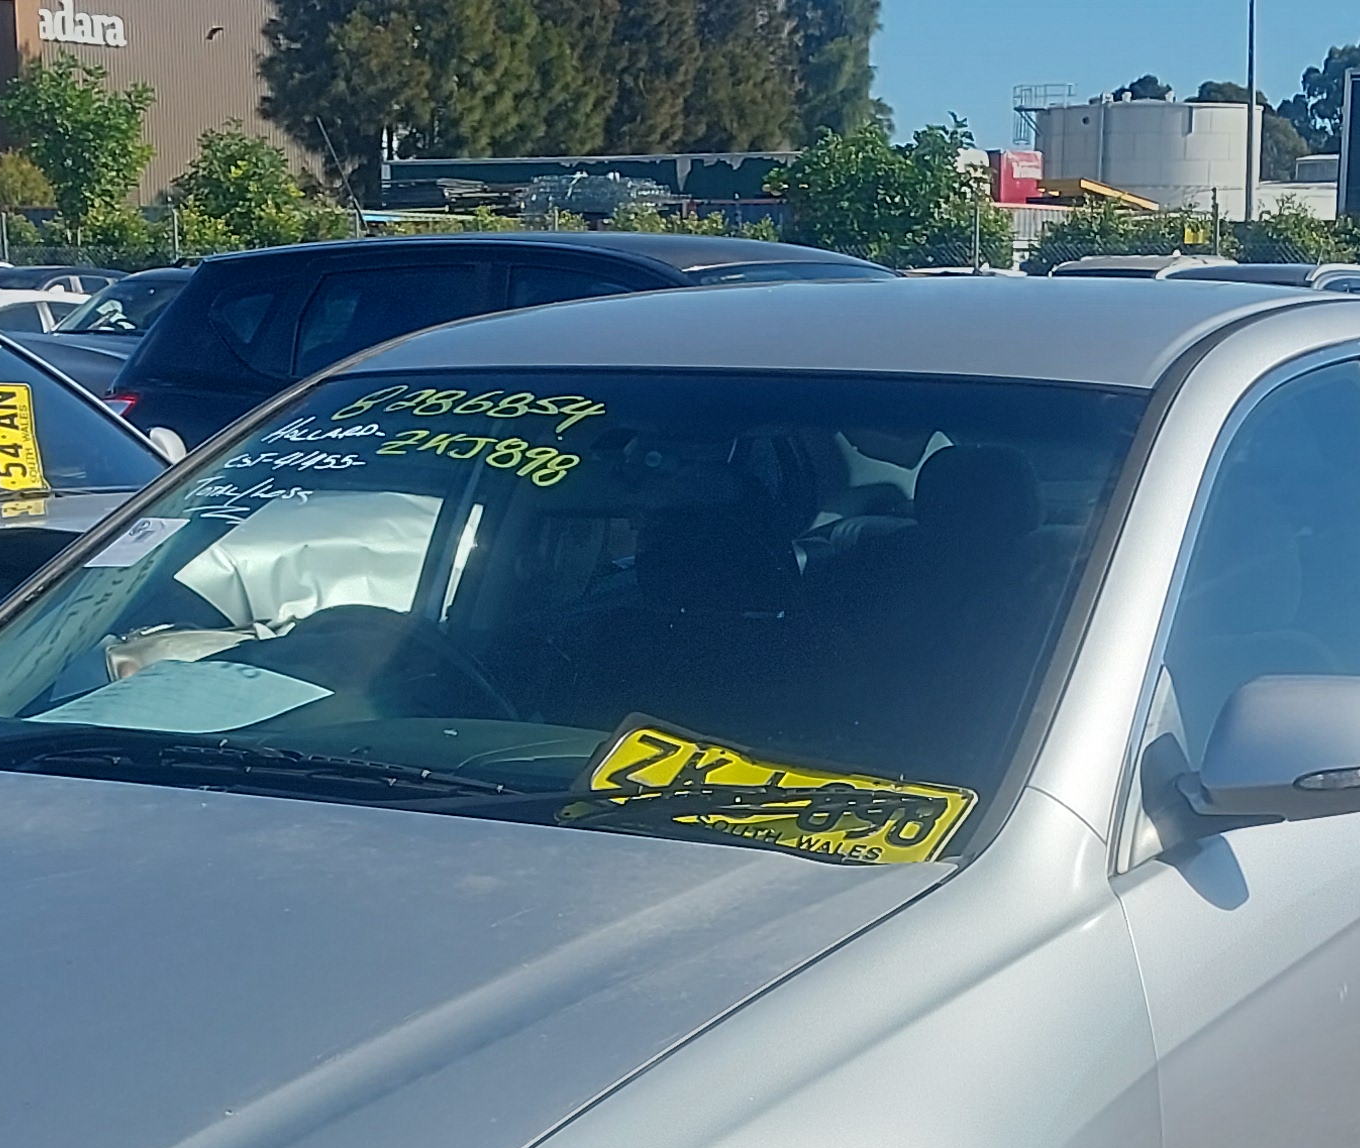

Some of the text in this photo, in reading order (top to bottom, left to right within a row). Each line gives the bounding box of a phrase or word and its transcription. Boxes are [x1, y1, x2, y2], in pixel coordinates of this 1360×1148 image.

[38, 0, 128, 47] adara
[19, 403, 32, 442] WALES
[376, 429, 581, 487] ZKJ898
[798, 834, 883, 862] WALES
